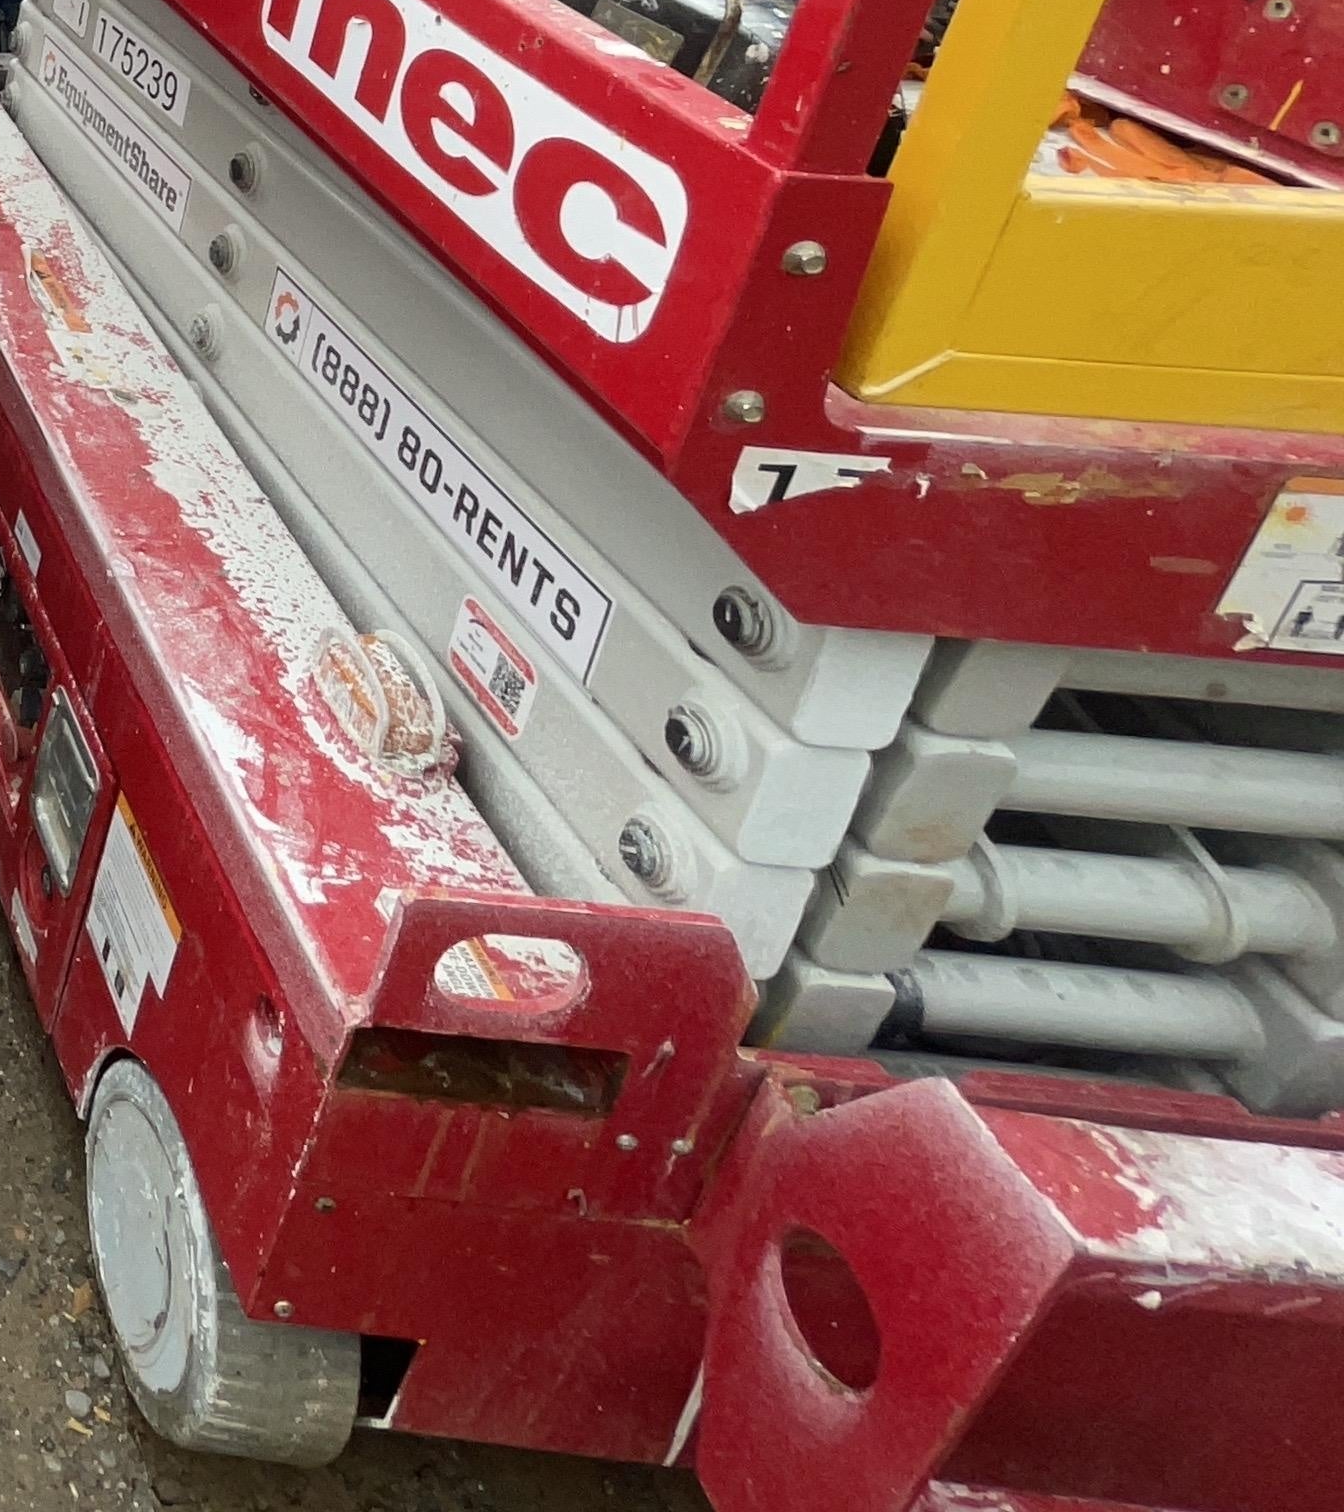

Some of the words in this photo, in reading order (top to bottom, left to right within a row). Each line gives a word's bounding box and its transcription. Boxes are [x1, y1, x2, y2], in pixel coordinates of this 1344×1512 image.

[55, 64, 177, 212] EquipmentShare
[98, 17, 178, 112] 175239
[311, 332, 392, 442] (888)
[396, 425, 582, 642] 80-RENTS
